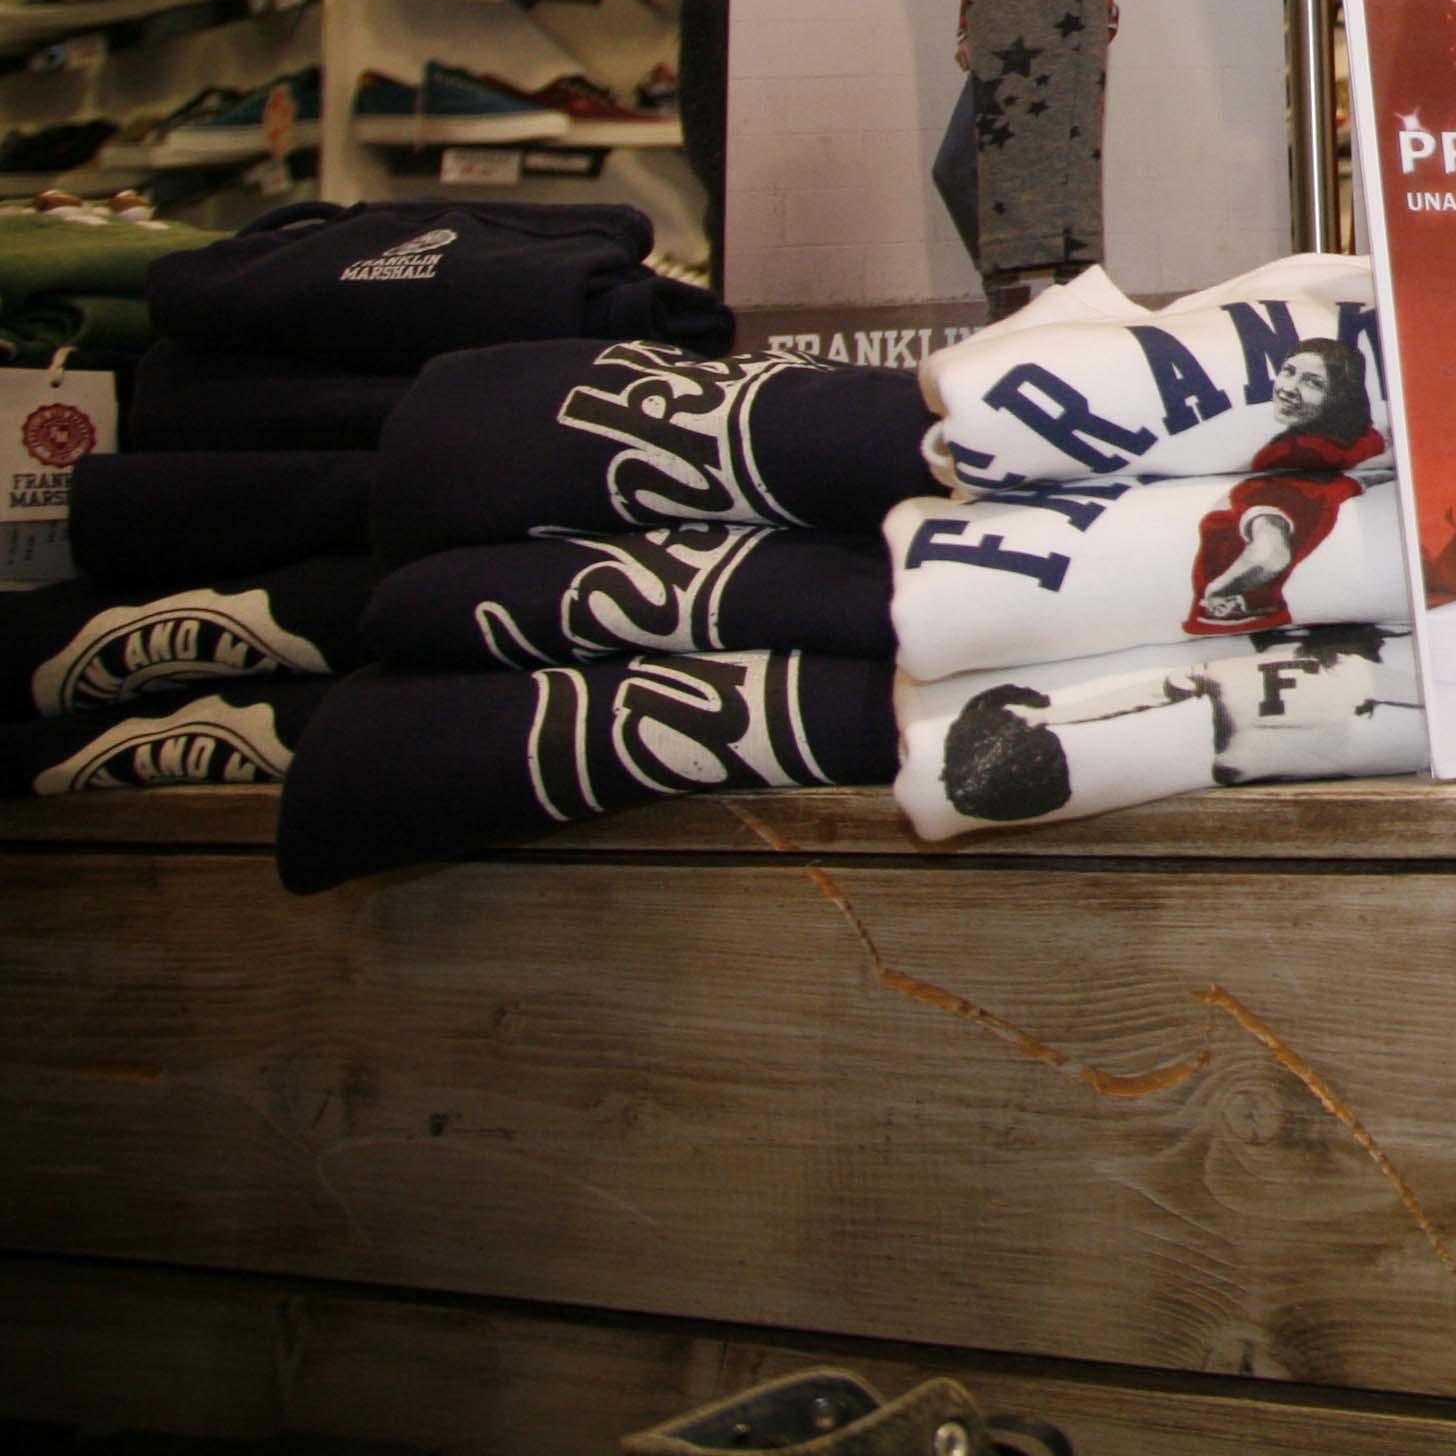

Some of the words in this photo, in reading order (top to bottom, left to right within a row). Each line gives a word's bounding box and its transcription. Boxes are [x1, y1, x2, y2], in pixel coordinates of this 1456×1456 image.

[340, 265, 437, 280] MARSHALL
[124, 617, 200, 673] AND
[1258, 659, 1319, 717] F
